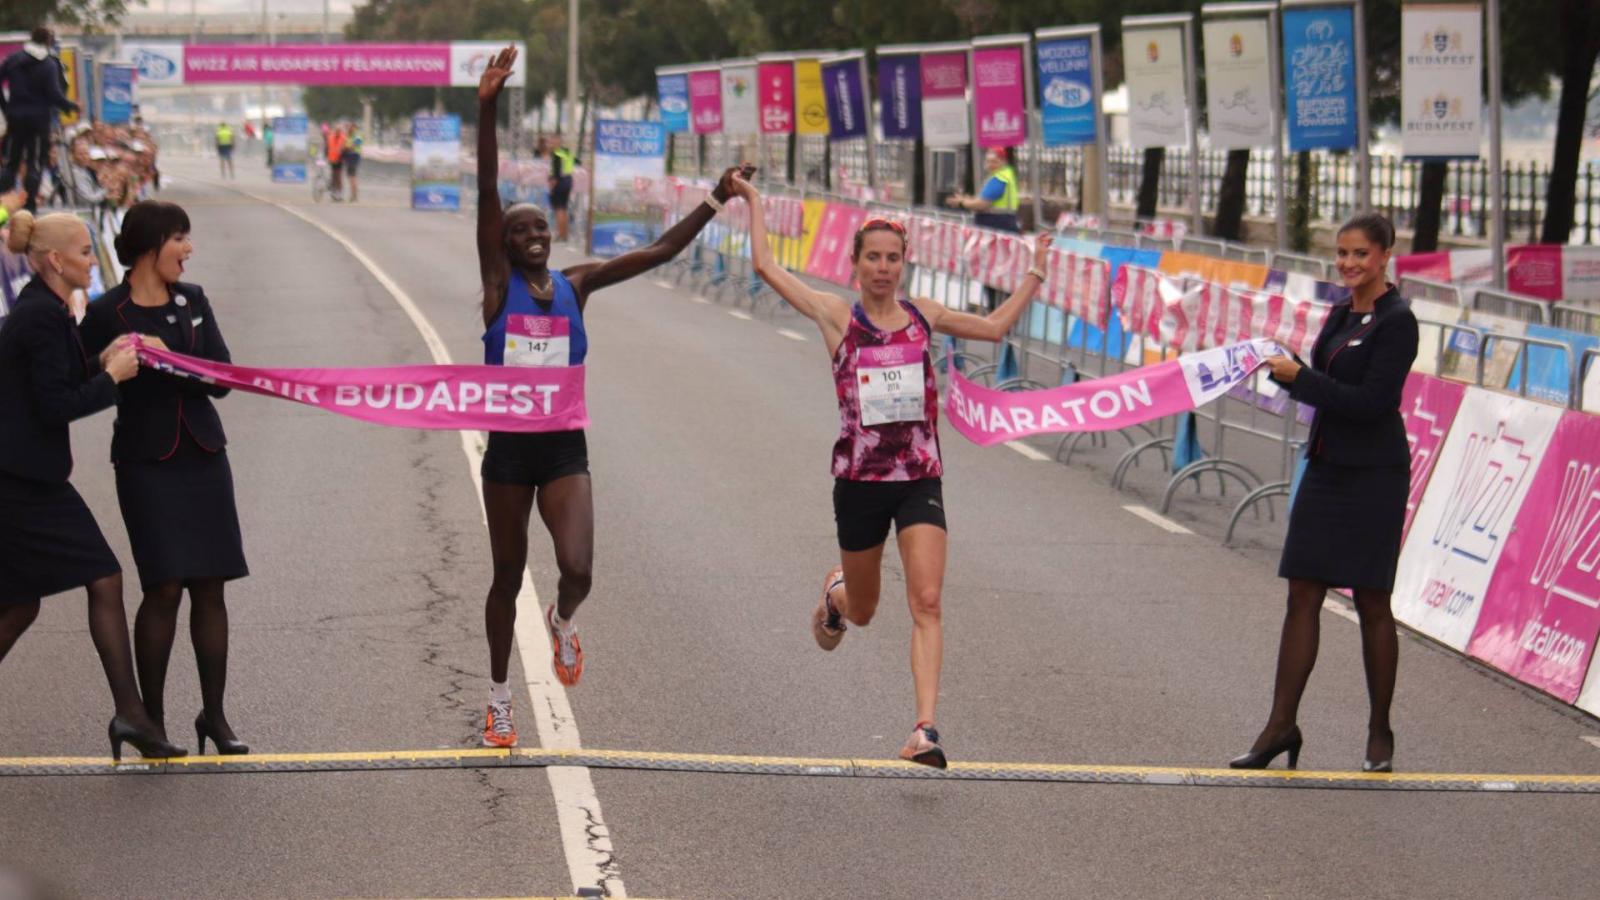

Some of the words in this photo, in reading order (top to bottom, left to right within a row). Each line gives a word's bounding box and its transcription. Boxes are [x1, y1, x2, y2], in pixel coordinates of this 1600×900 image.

[188, 57, 227, 71] WIZZ
[231, 57, 258, 71] AIR
[261, 57, 340, 71] BUDAPEST
[1407, 56, 1475, 66] BUDAPEST
[1407, 122, 1475, 132] BUDAPEST
[528, 341, 549, 353] 147
[882, 370, 902, 382] 101
[335, 381, 560, 416] BUDAPEST
